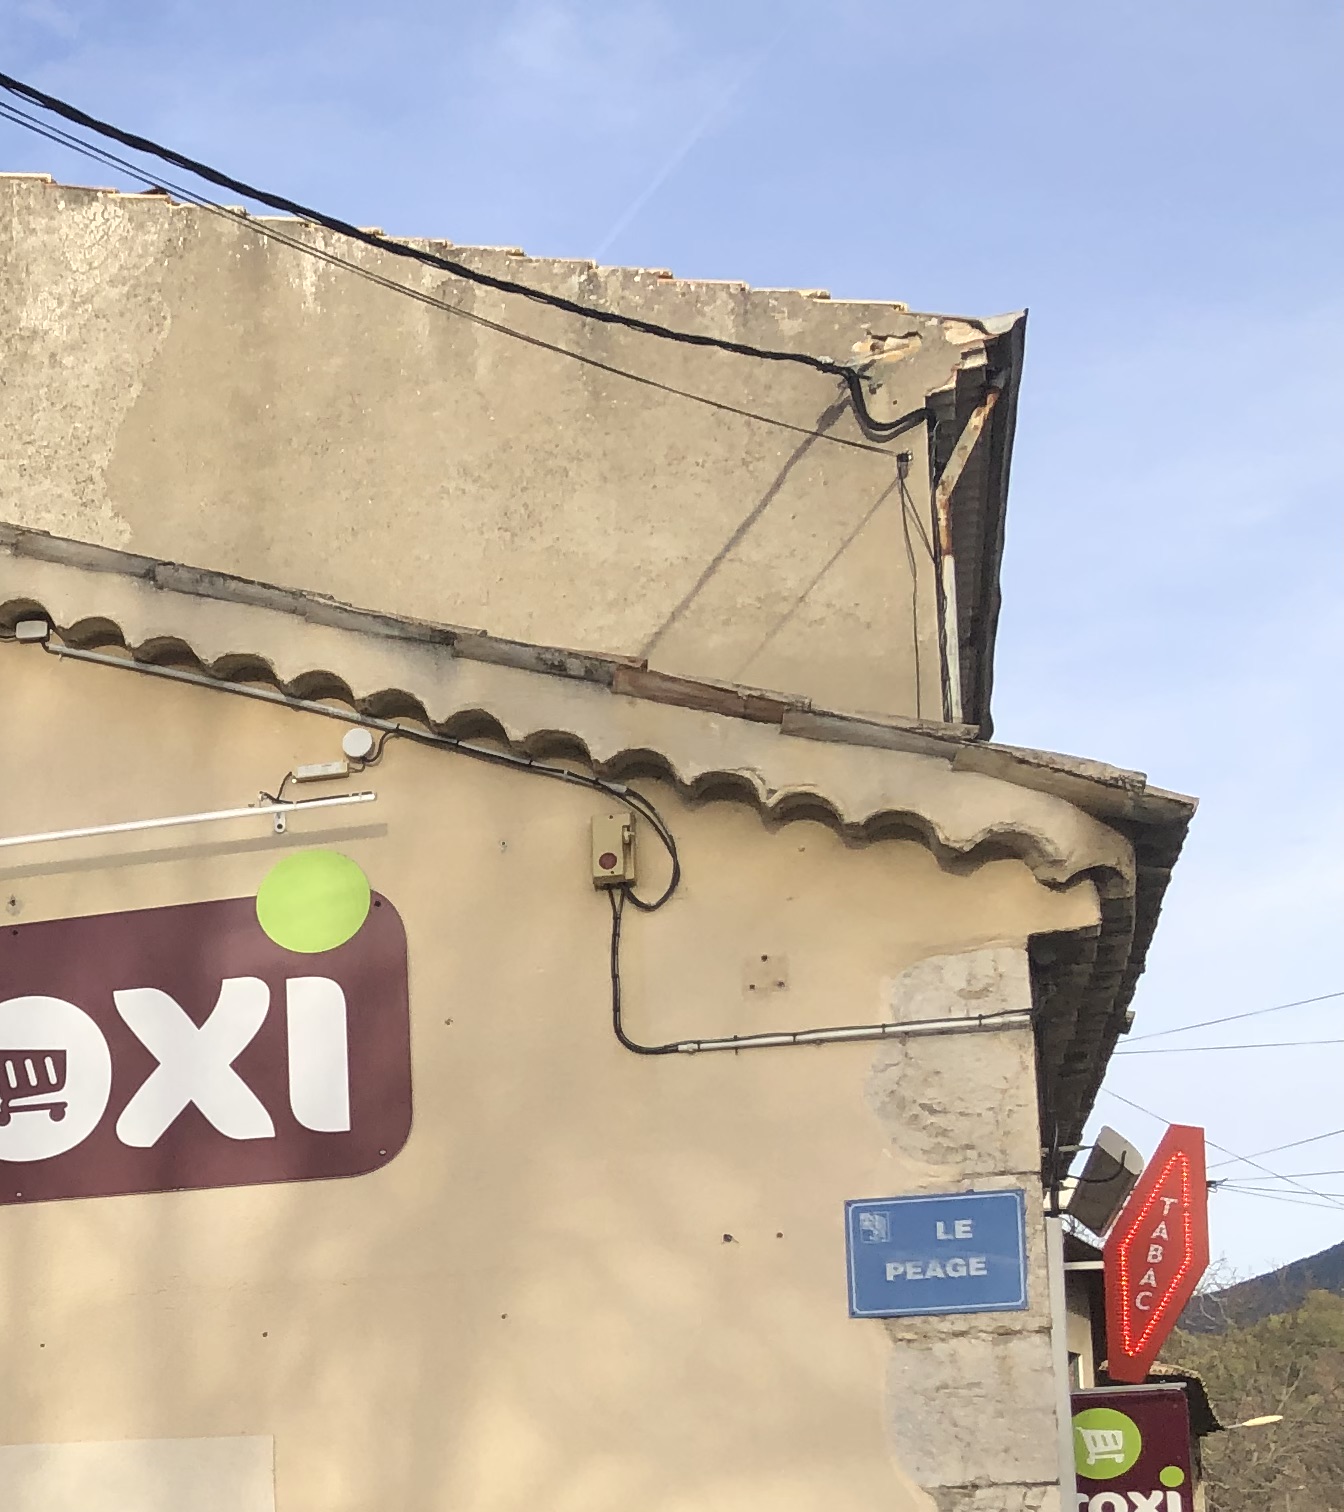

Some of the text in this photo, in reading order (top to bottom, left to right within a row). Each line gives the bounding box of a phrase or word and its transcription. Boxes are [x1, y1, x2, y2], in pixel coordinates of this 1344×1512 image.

[936, 1219, 973, 1240] LE
[1135, 1197, 1179, 1311] TABAC
[885, 1256, 988, 1282] PEAGE
